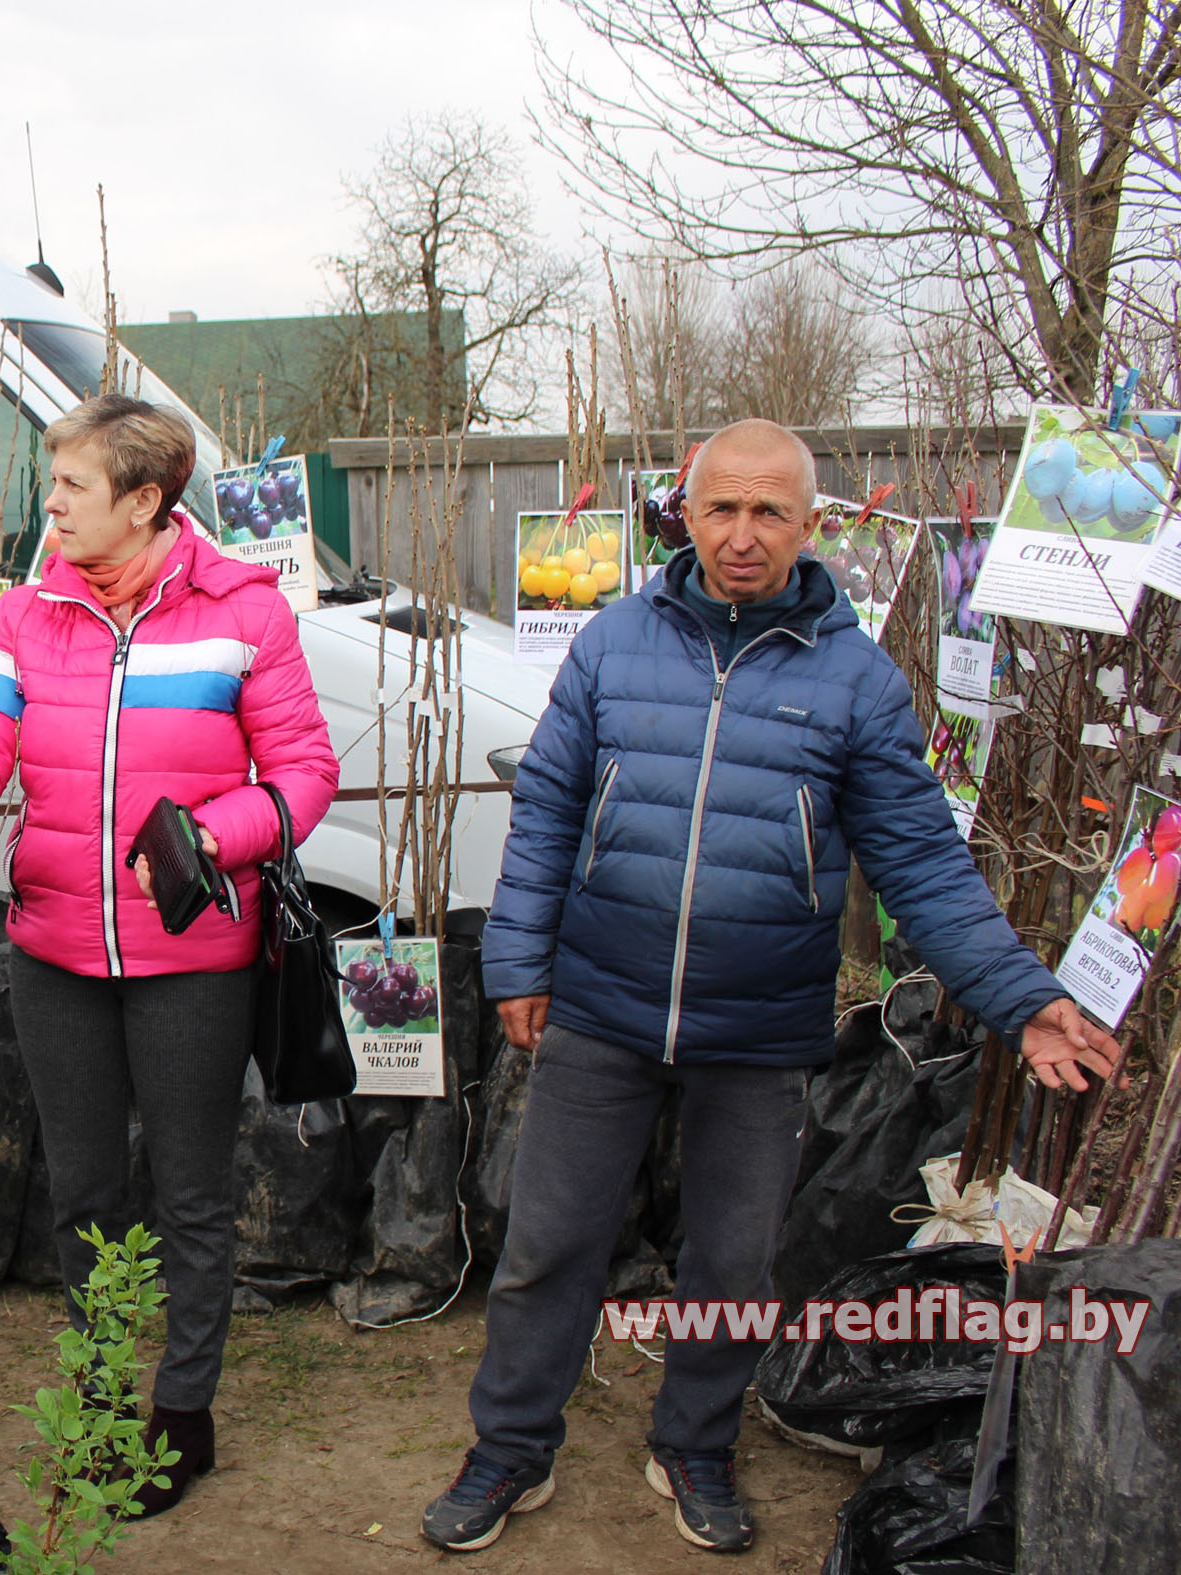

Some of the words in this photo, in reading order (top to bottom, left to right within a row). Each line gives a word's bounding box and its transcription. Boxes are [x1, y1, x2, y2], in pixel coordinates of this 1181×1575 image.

[239, 539, 292, 556] ЧЕРЕШНЯ
[1019, 544, 1112, 571] СТЕНЛИ
[519, 622, 579, 636] ГИБРИД
[950, 655, 979, 676] ВОЛАТ
[1079, 929, 1141, 977] АБРИКОСОВАЯ
[1077, 952, 1113, 986] ВЕТРАЗЬ
[1110, 977, 1121, 990] 2
[362, 1039, 423, 1054] ВАЛЕРИЙ
[367, 1056, 420, 1068] ЧКАЛОВ
